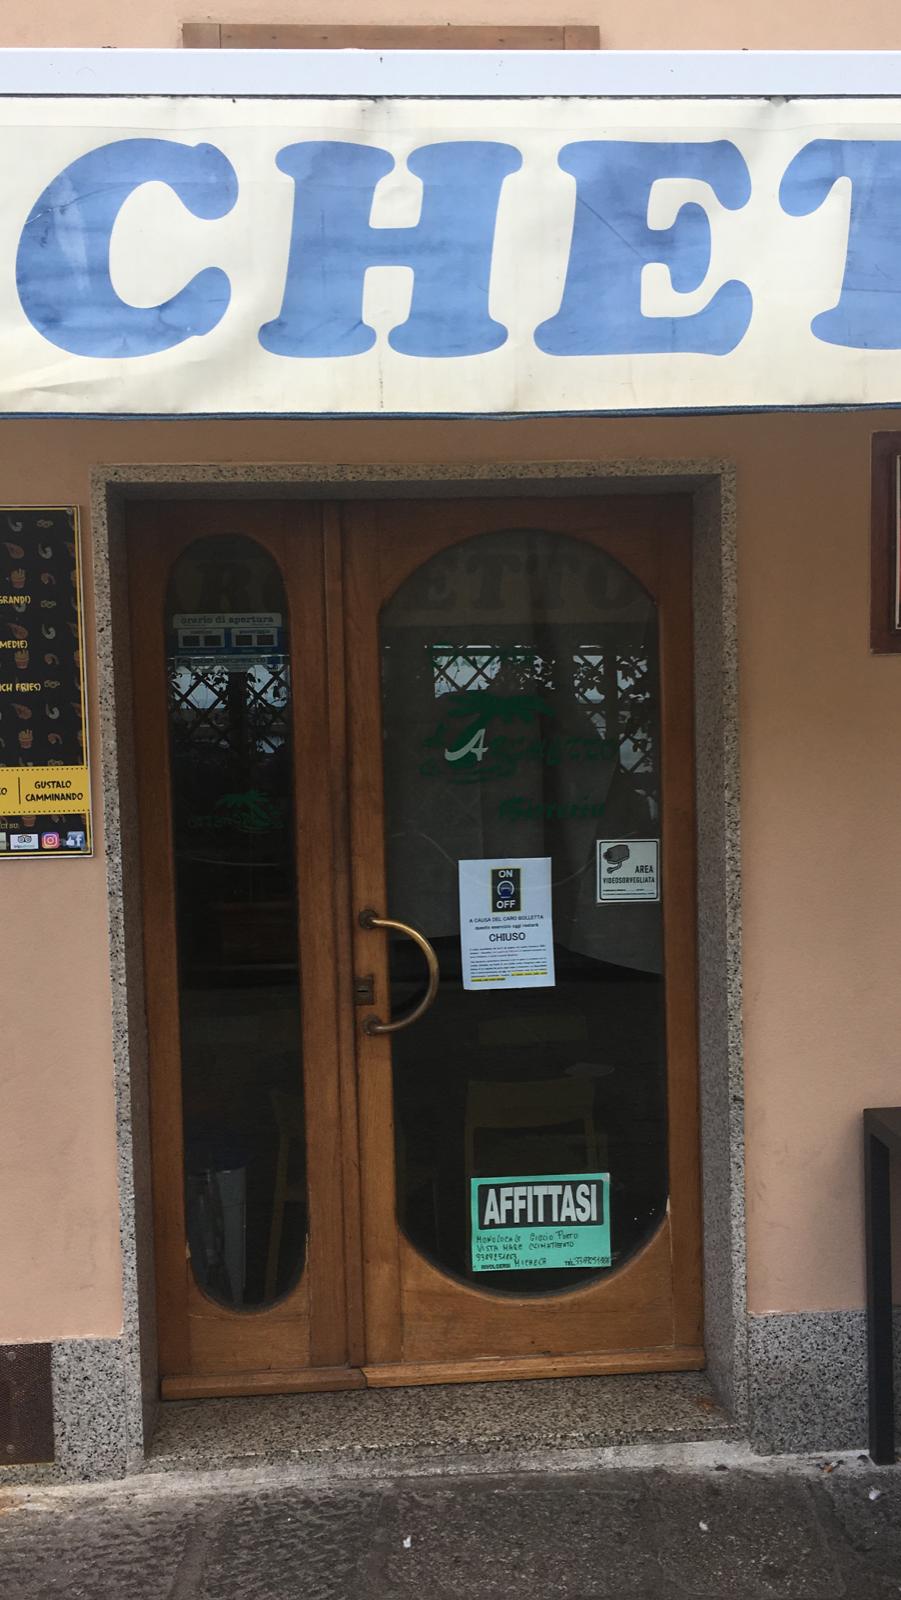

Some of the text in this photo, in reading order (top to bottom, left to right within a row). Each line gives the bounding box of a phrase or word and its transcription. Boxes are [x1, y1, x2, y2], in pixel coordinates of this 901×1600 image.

[180, 615, 274, 624] orario di apertura
[34, 780, 72, 789] GUSTALO
[25, 792, 83, 802] CAMMINANDO
[498, 869, 513, 878] ON
[635, 865, 654, 874] AREA
[496, 899, 516, 909] OFF
[489, 932, 526, 942] CHIUSO
[483, 1183, 597, 1225] AFFITTASI
